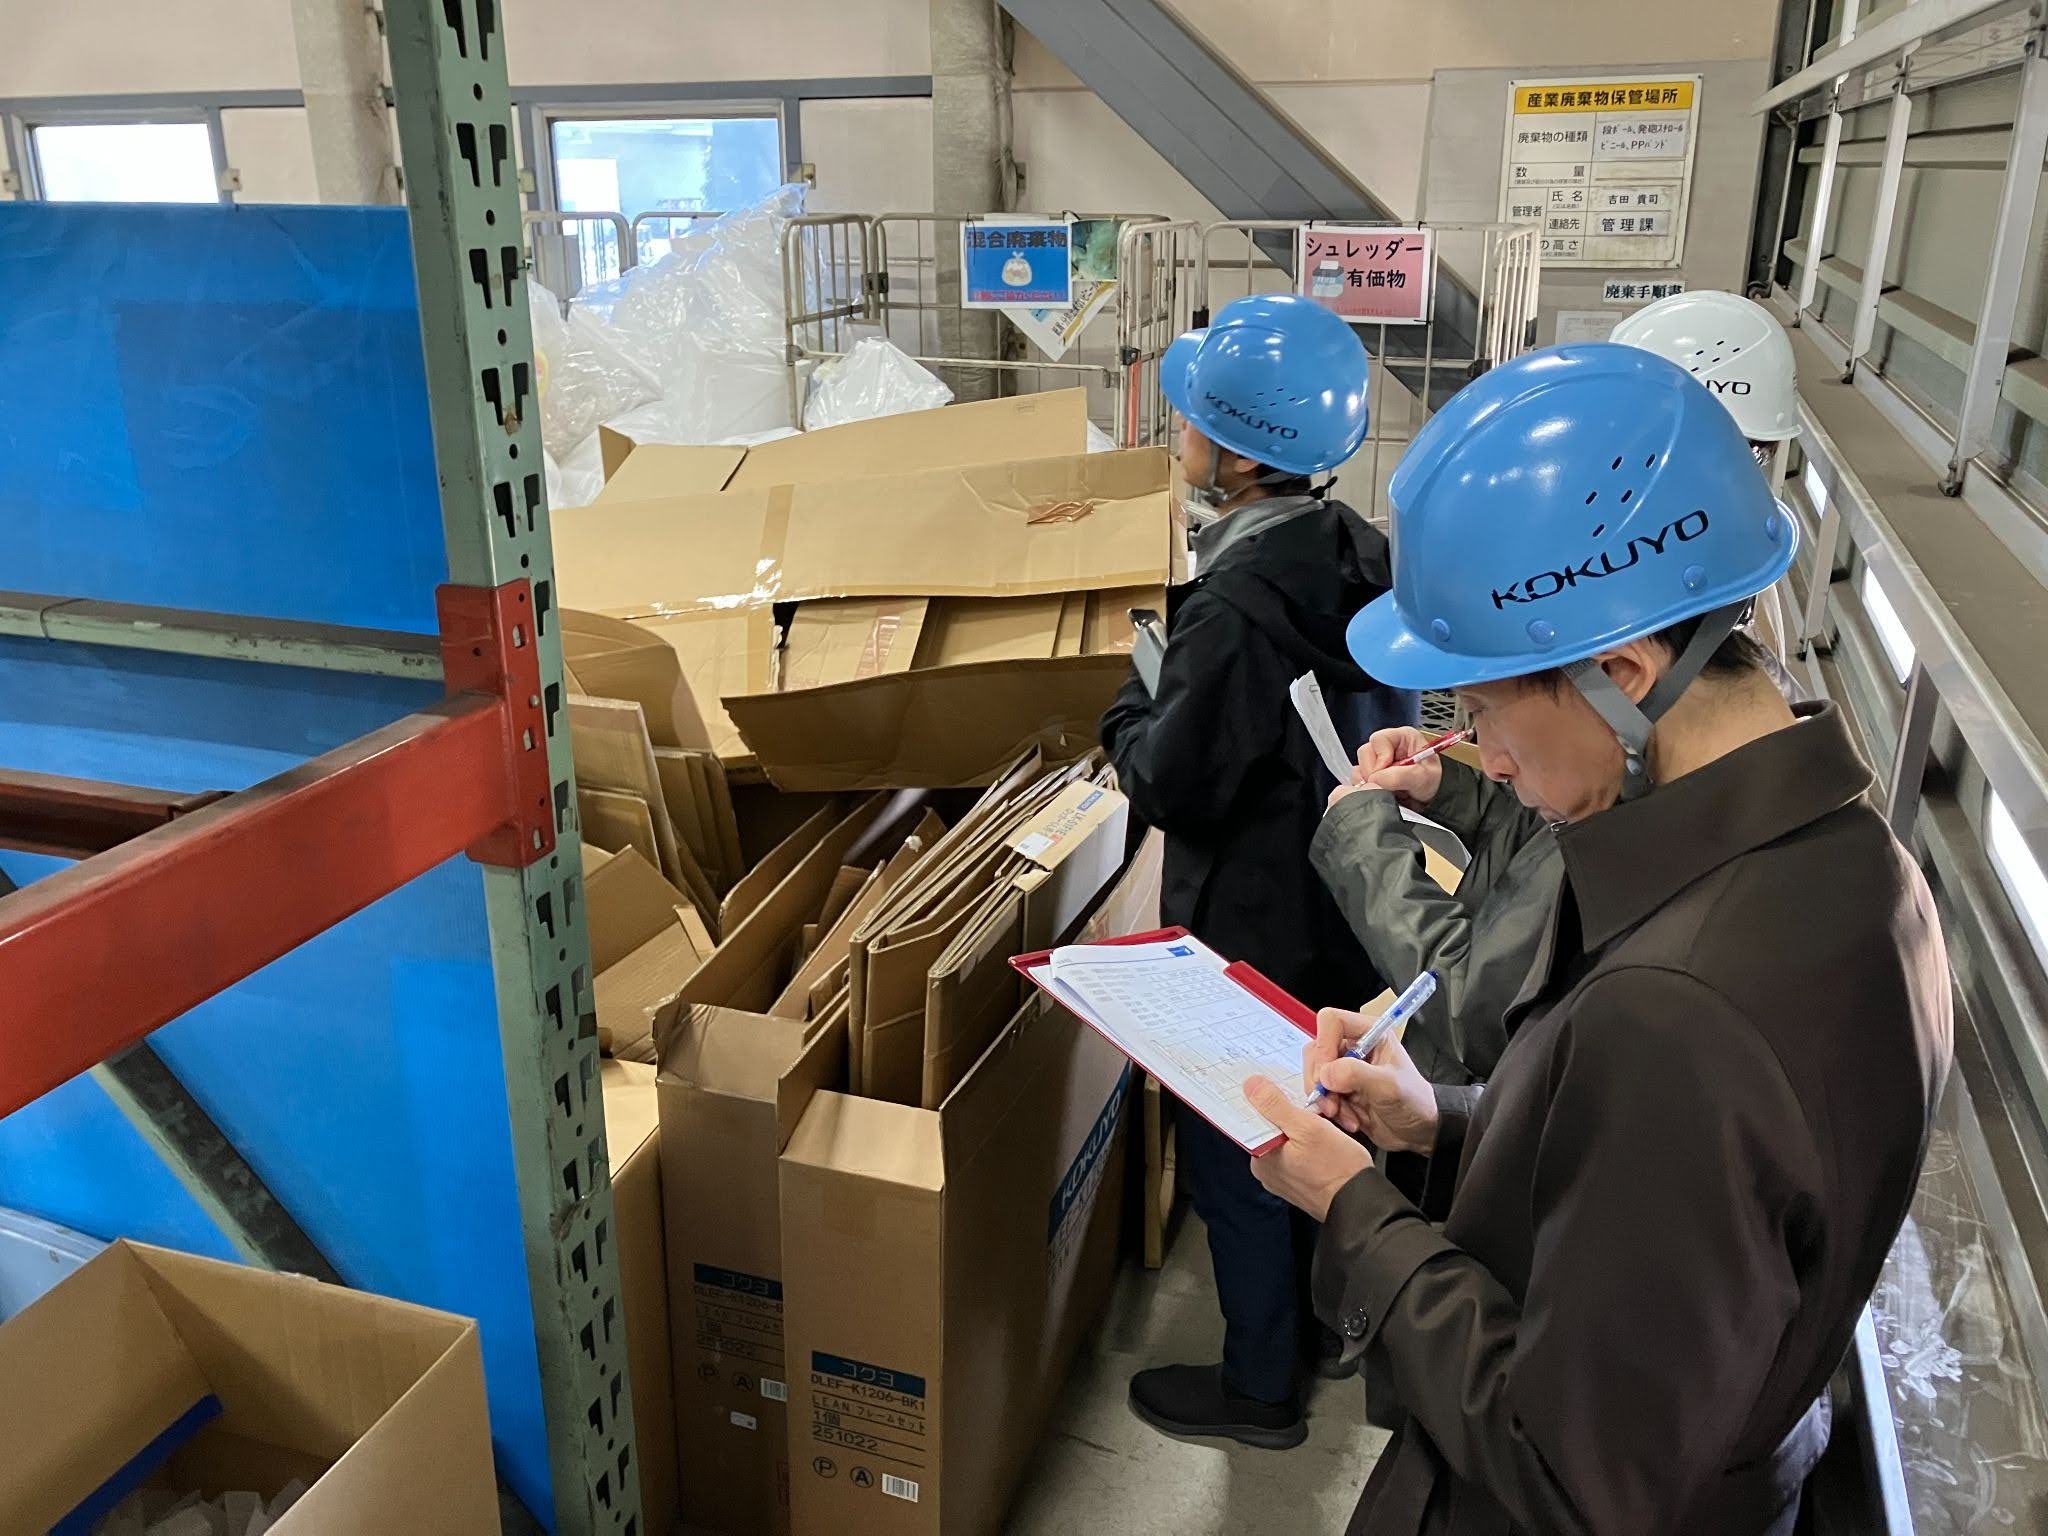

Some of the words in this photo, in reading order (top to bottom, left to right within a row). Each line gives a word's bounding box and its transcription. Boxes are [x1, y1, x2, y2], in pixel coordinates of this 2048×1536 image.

[1527, 88, 1678, 108] 産業廃棄物保管場所
[1517, 130, 1588, 143] 廃棄物の種類
[1512, 205, 1542, 217] 管理者
[1548, 218, 1580, 231] 連絡先
[1602, 217, 1654, 232] 管理課
[966, 230, 1068, 249] 混合廃棄物
[1307, 237, 1423, 261] シュレッダー
[1346, 268, 1406, 289] 有価物
[1205, 391, 1298, 440] KOKUYO
[1491, 509, 1709, 610] KOKUYO
[1060, 1088, 1121, 1213] KOKUYO
[842, 1361, 894, 1387] コクヨ
[811, 1374, 926, 1411] DLEF-K1206-BK1
[812, 1394, 850, 1412] LEAN
[857, 1406, 925, 1433] フレームセット
[813, 1409, 841, 1427] 1個
[812, 1425, 878, 1451] 251022
